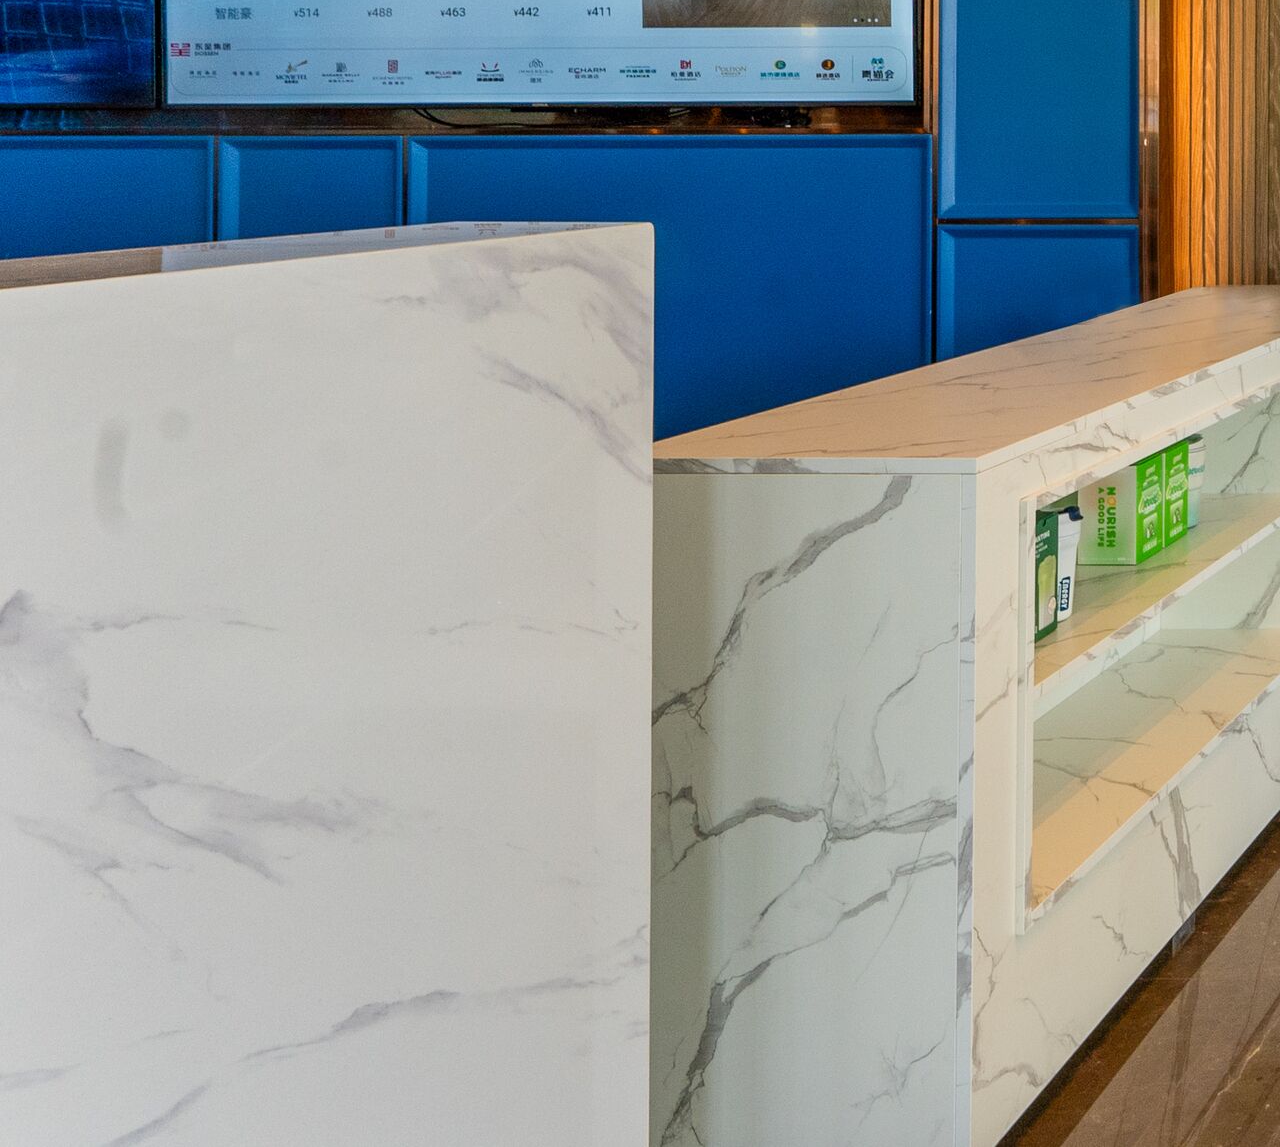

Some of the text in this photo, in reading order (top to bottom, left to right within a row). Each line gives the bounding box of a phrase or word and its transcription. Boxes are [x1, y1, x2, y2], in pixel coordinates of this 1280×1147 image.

[294, 8, 320, 18] ¥514
[367, 8, 392, 17] ¥488
[440, 7, 466, 17] ¥463
[514, 7, 539, 17] ¥442
[587, 7, 611, 16] ¥411
[1098, 487, 1105, 495] A
[1106, 486, 1117, 548] NOURISH
